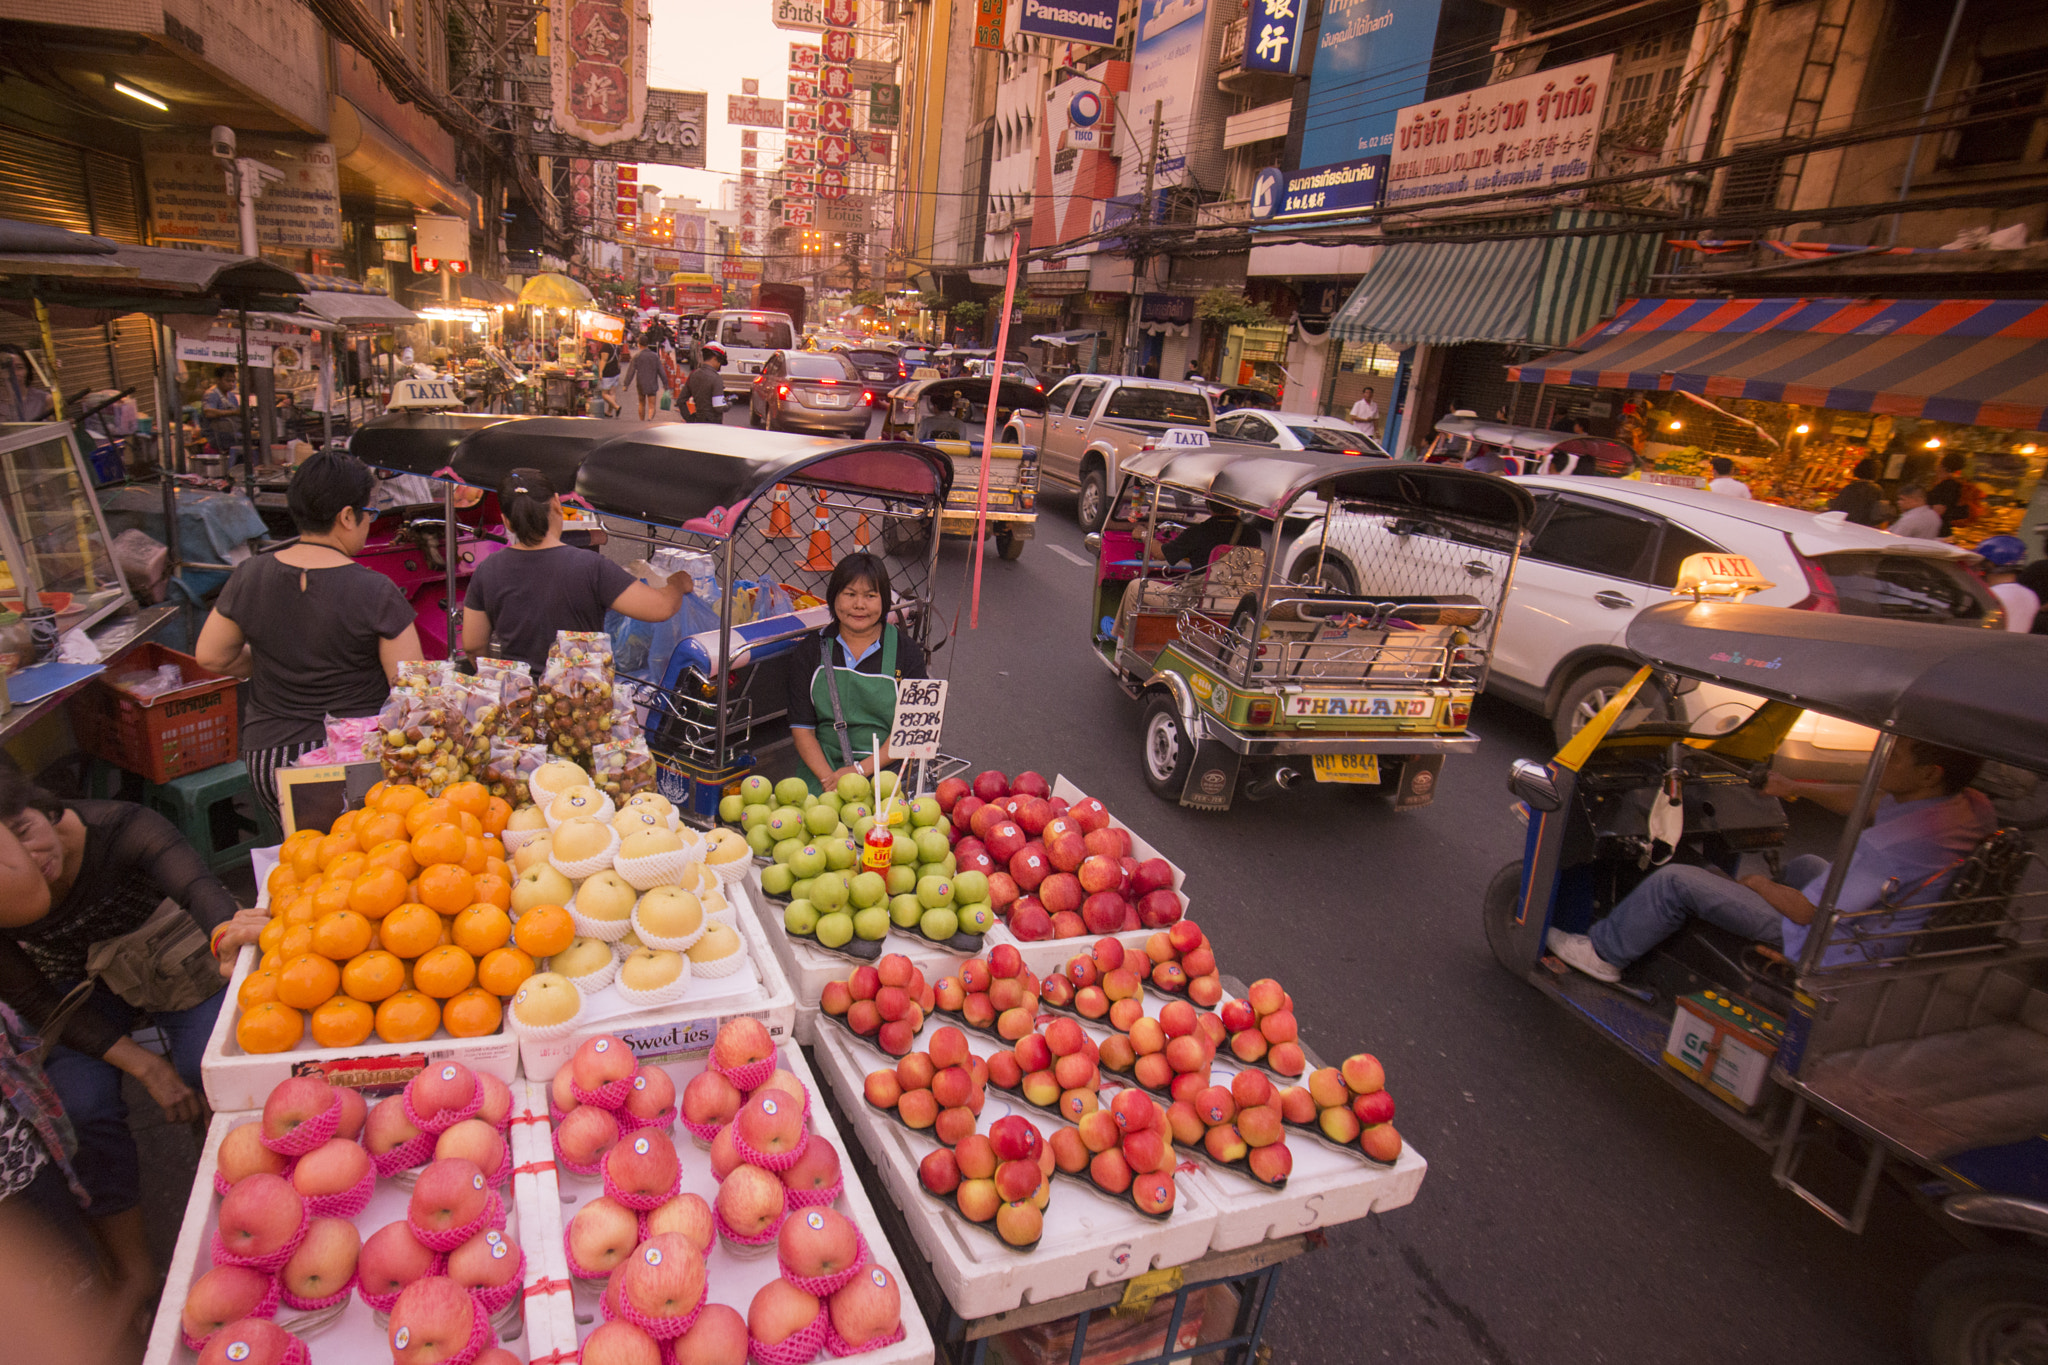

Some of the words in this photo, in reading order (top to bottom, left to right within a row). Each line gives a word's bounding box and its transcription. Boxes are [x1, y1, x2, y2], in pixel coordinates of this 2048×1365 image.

[1025, 0, 1113, 30] Panasonic
[1400, 108, 1449, 150] บริษัท
[1537, 73, 1598, 123] จำกัด
[1075, 130, 1093, 141] TISCO
[827, 199, 864, 208] TESCO
[827, 210, 863, 222] Lotus
[406, 384, 447, 399] TAXI
[1174, 432, 1203, 446] TAXI
[1703, 556, 1753, 577] TAXI
[1297, 697, 1426, 716] THAILAND
[622, 1025, 709, 1052] Sweeties
